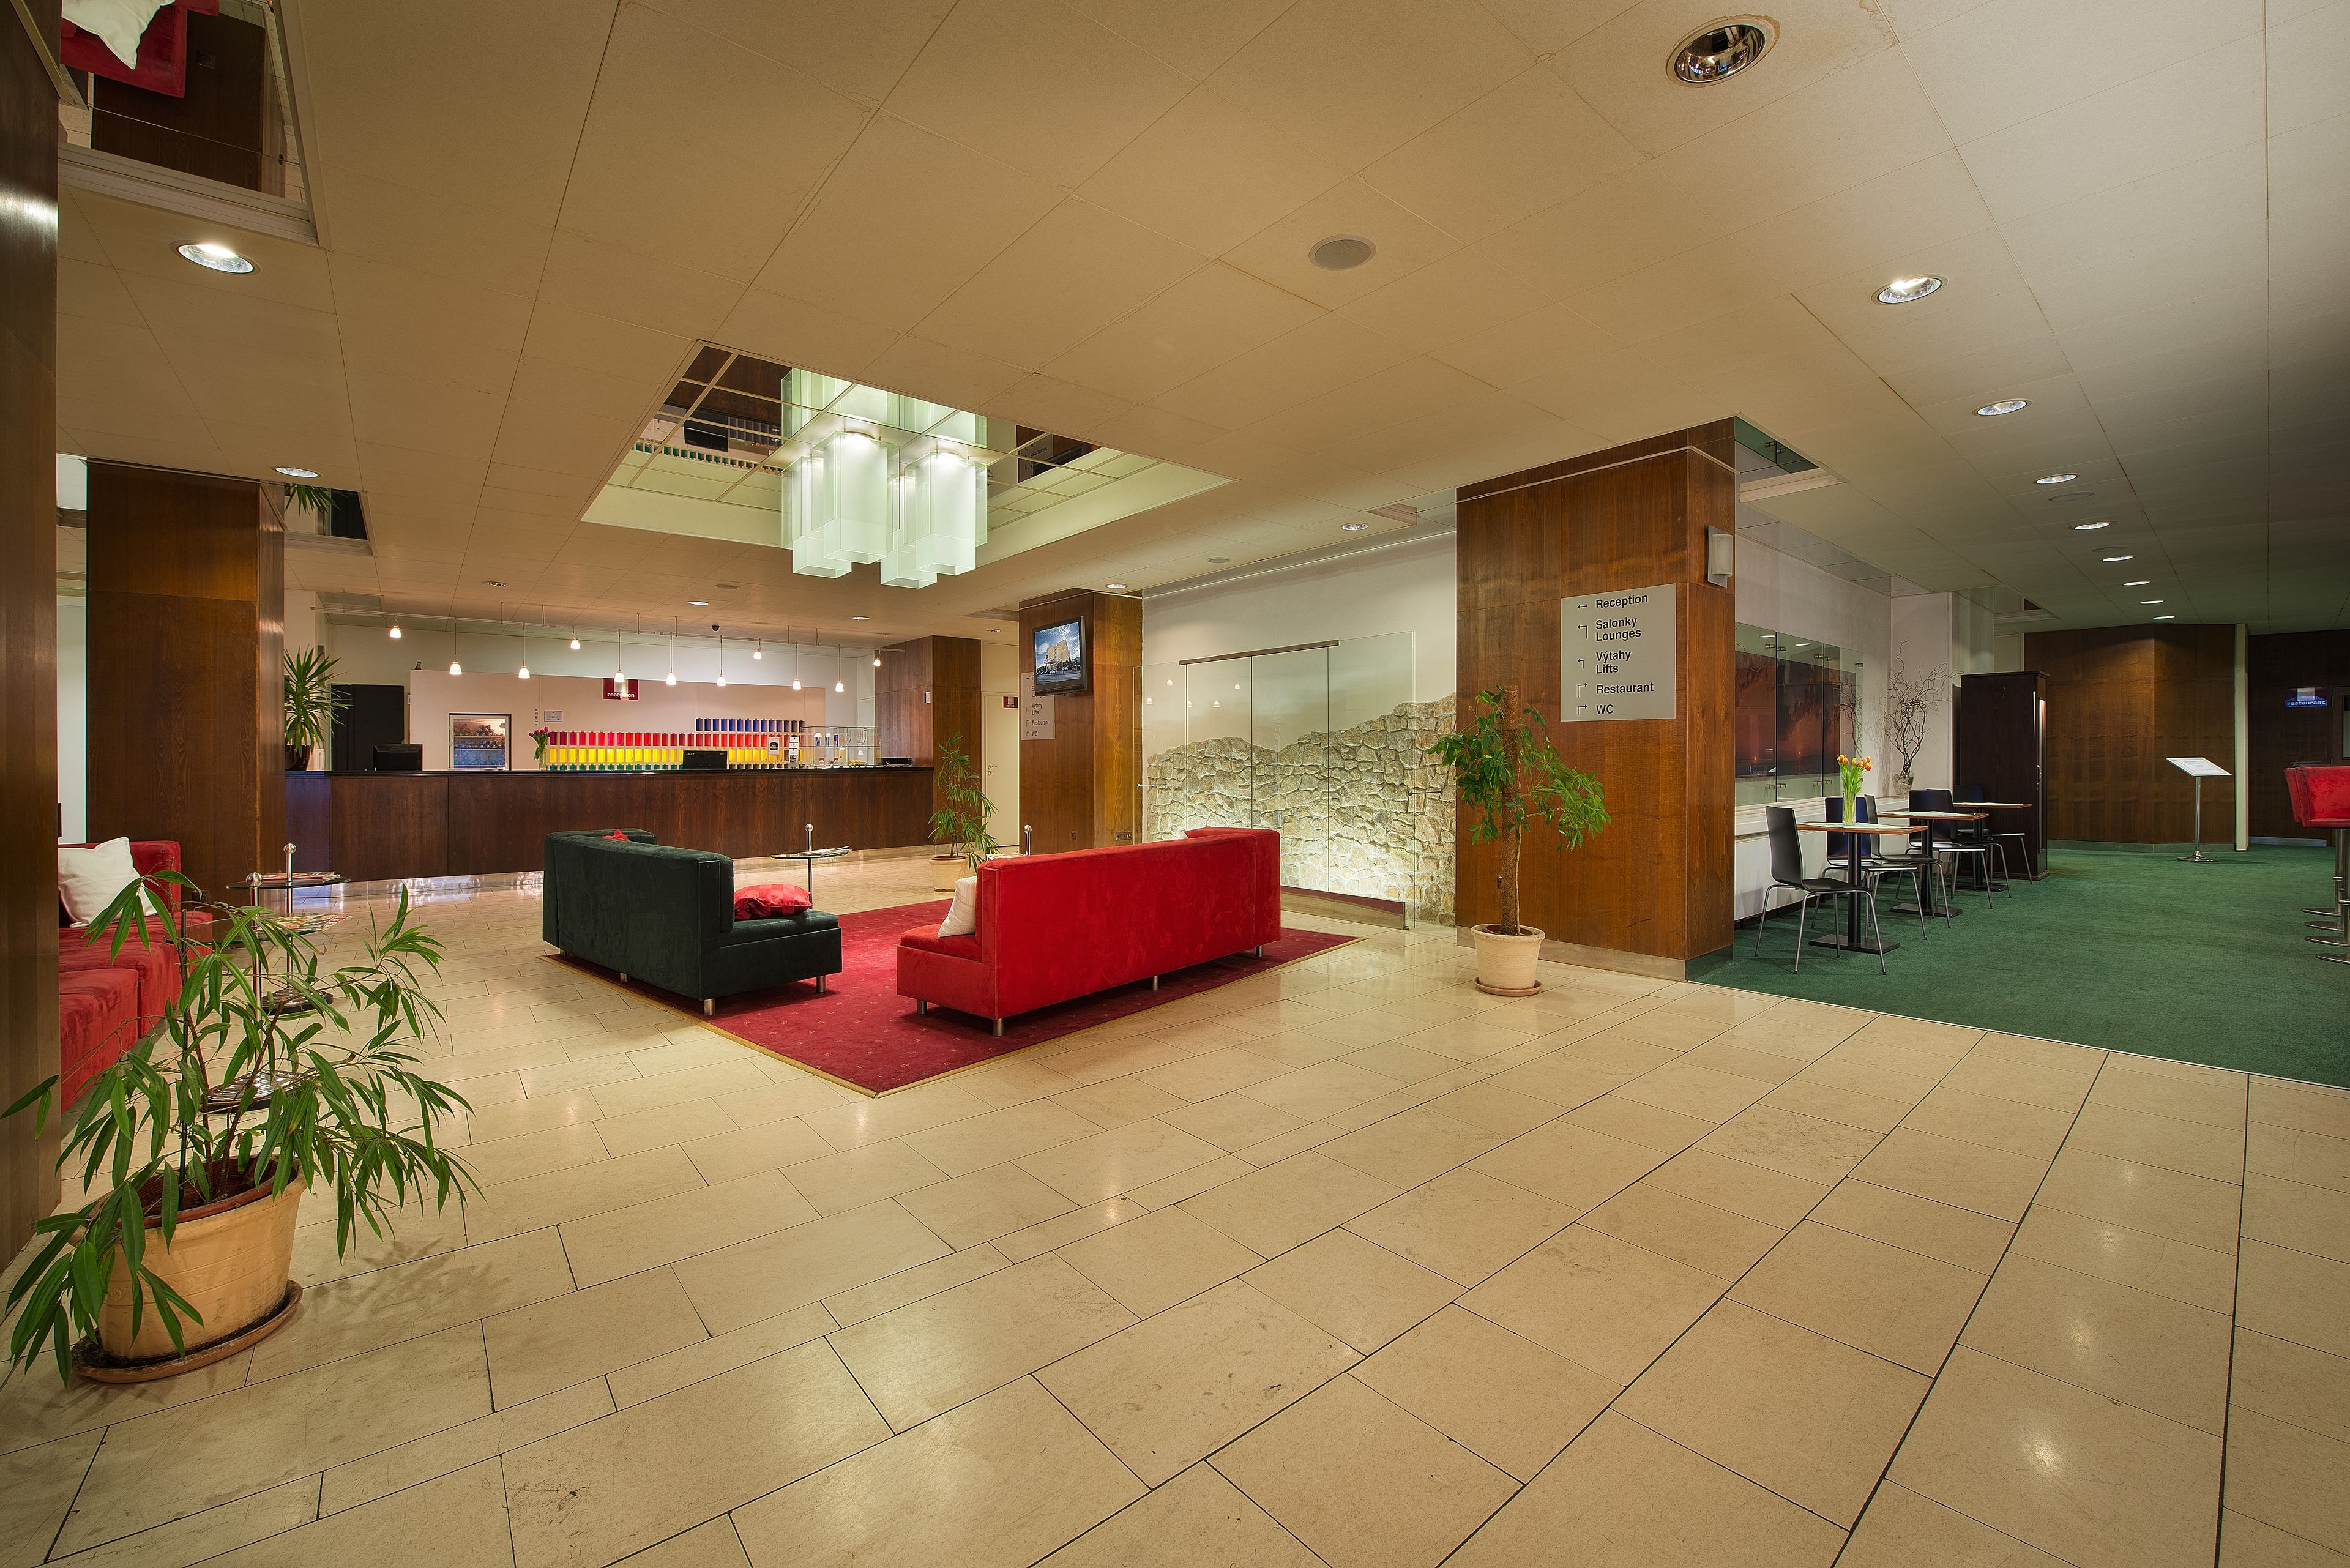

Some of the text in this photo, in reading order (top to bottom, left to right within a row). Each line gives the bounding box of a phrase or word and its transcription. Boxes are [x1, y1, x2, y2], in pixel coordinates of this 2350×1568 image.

[1595, 594, 1648, 609] Reception
[1595, 616, 1638, 629] Salonky
[1595, 629, 1641, 641] Lounges
[1595, 650, 1632, 663] Výtahy
[1596, 664, 1619, 674] Lifts
[1596, 682, 1654, 694] Restaurant
[1596, 704, 1614, 714] WC
